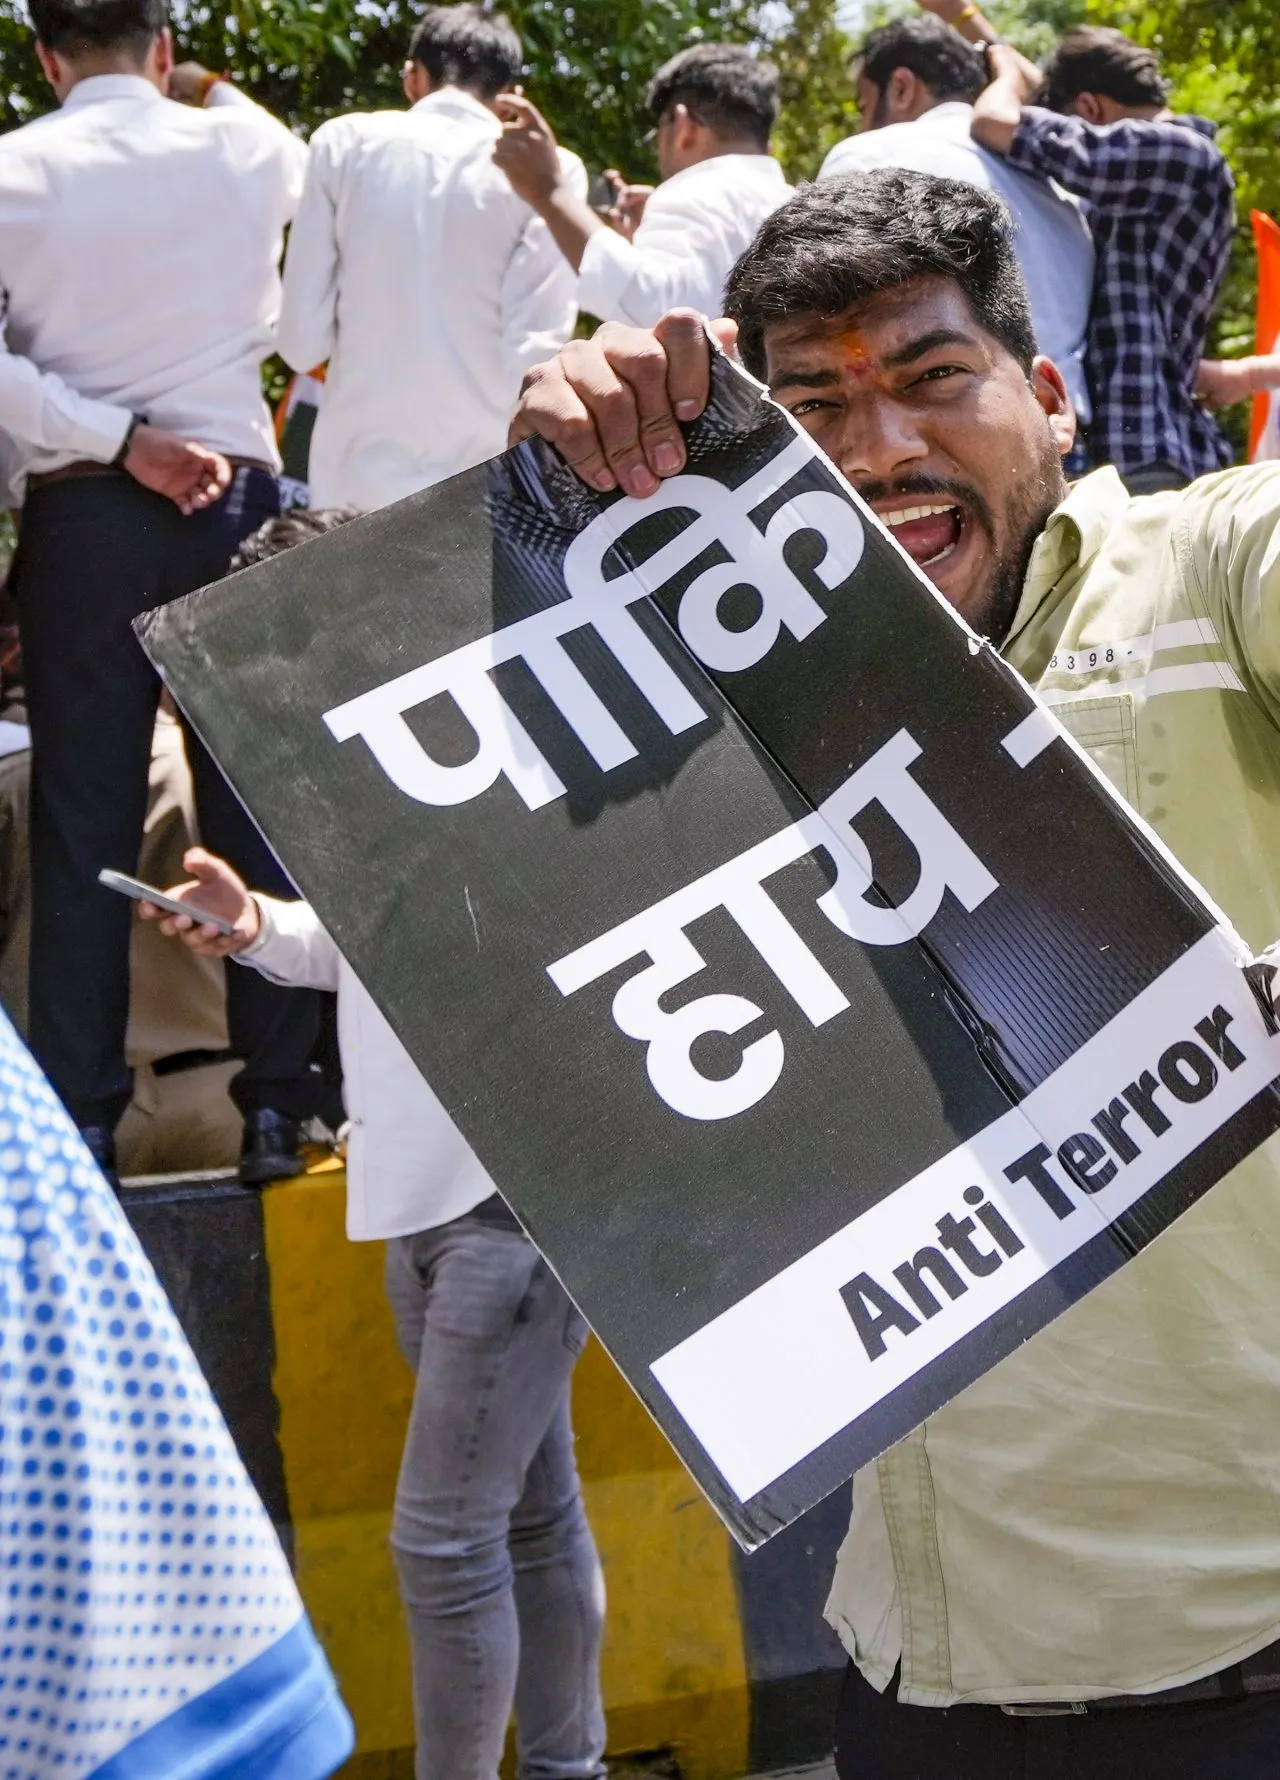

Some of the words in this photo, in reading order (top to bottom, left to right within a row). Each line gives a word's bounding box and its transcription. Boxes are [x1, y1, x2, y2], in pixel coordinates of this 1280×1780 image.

[322, 437, 866, 811] पाकि
[546, 727, 999, 1122] हाय
[838, 1185, 1025, 1362] Anti
[1002, 1004, 1248, 1221] Terror
